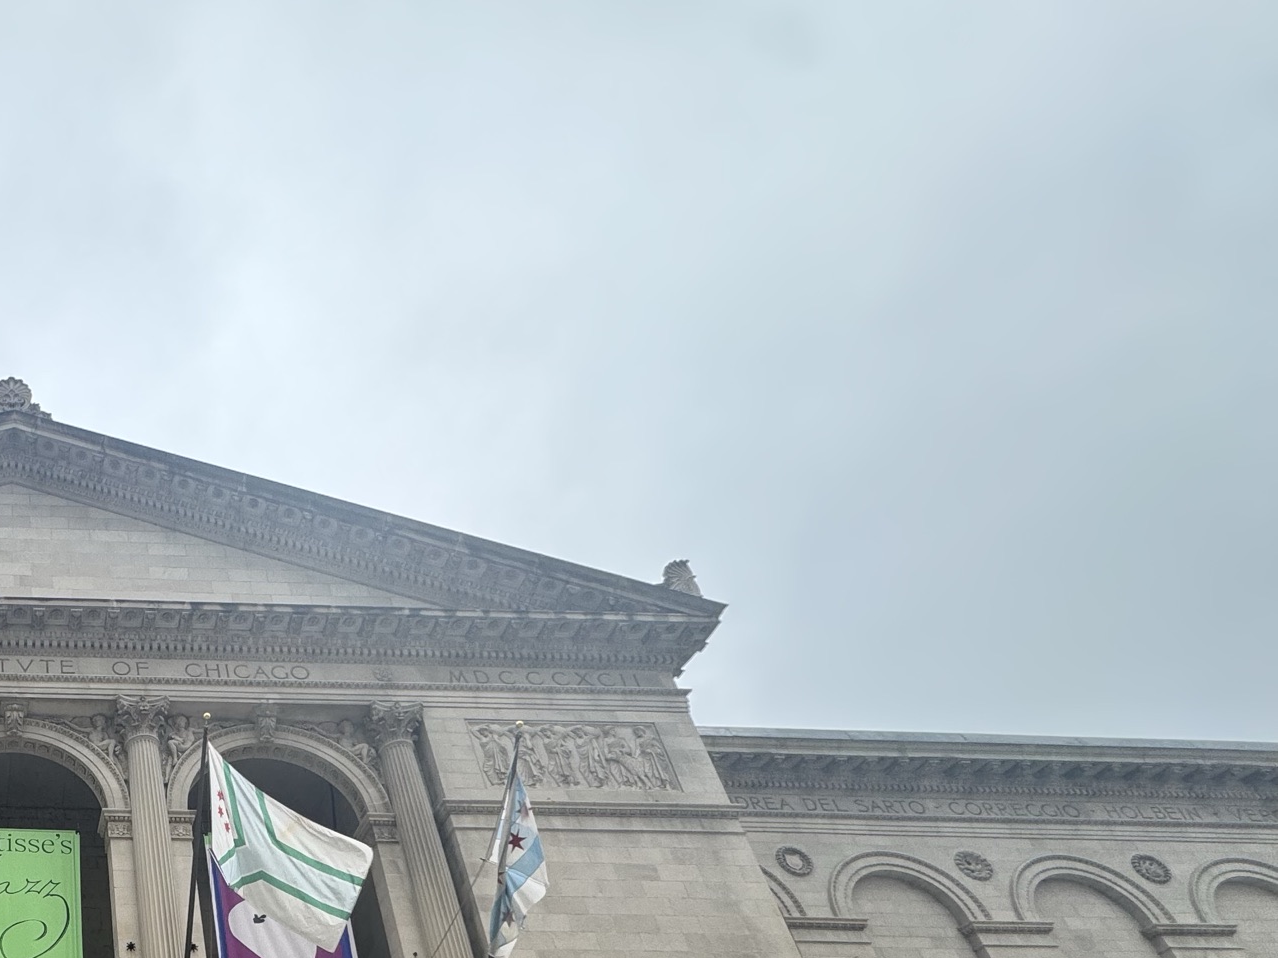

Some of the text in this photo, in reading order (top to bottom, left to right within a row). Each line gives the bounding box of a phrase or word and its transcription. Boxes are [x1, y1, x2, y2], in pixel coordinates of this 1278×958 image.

[111, 661, 150, 676] OF
[184, 663, 310, 680] CHICAGO
[801, 798, 849, 812] DEL
[858, 798, 925, 815] SARTO
[947, 801, 1080, 818] CORREGGIO
[1104, 803, 1204, 821] HOLBEIN
